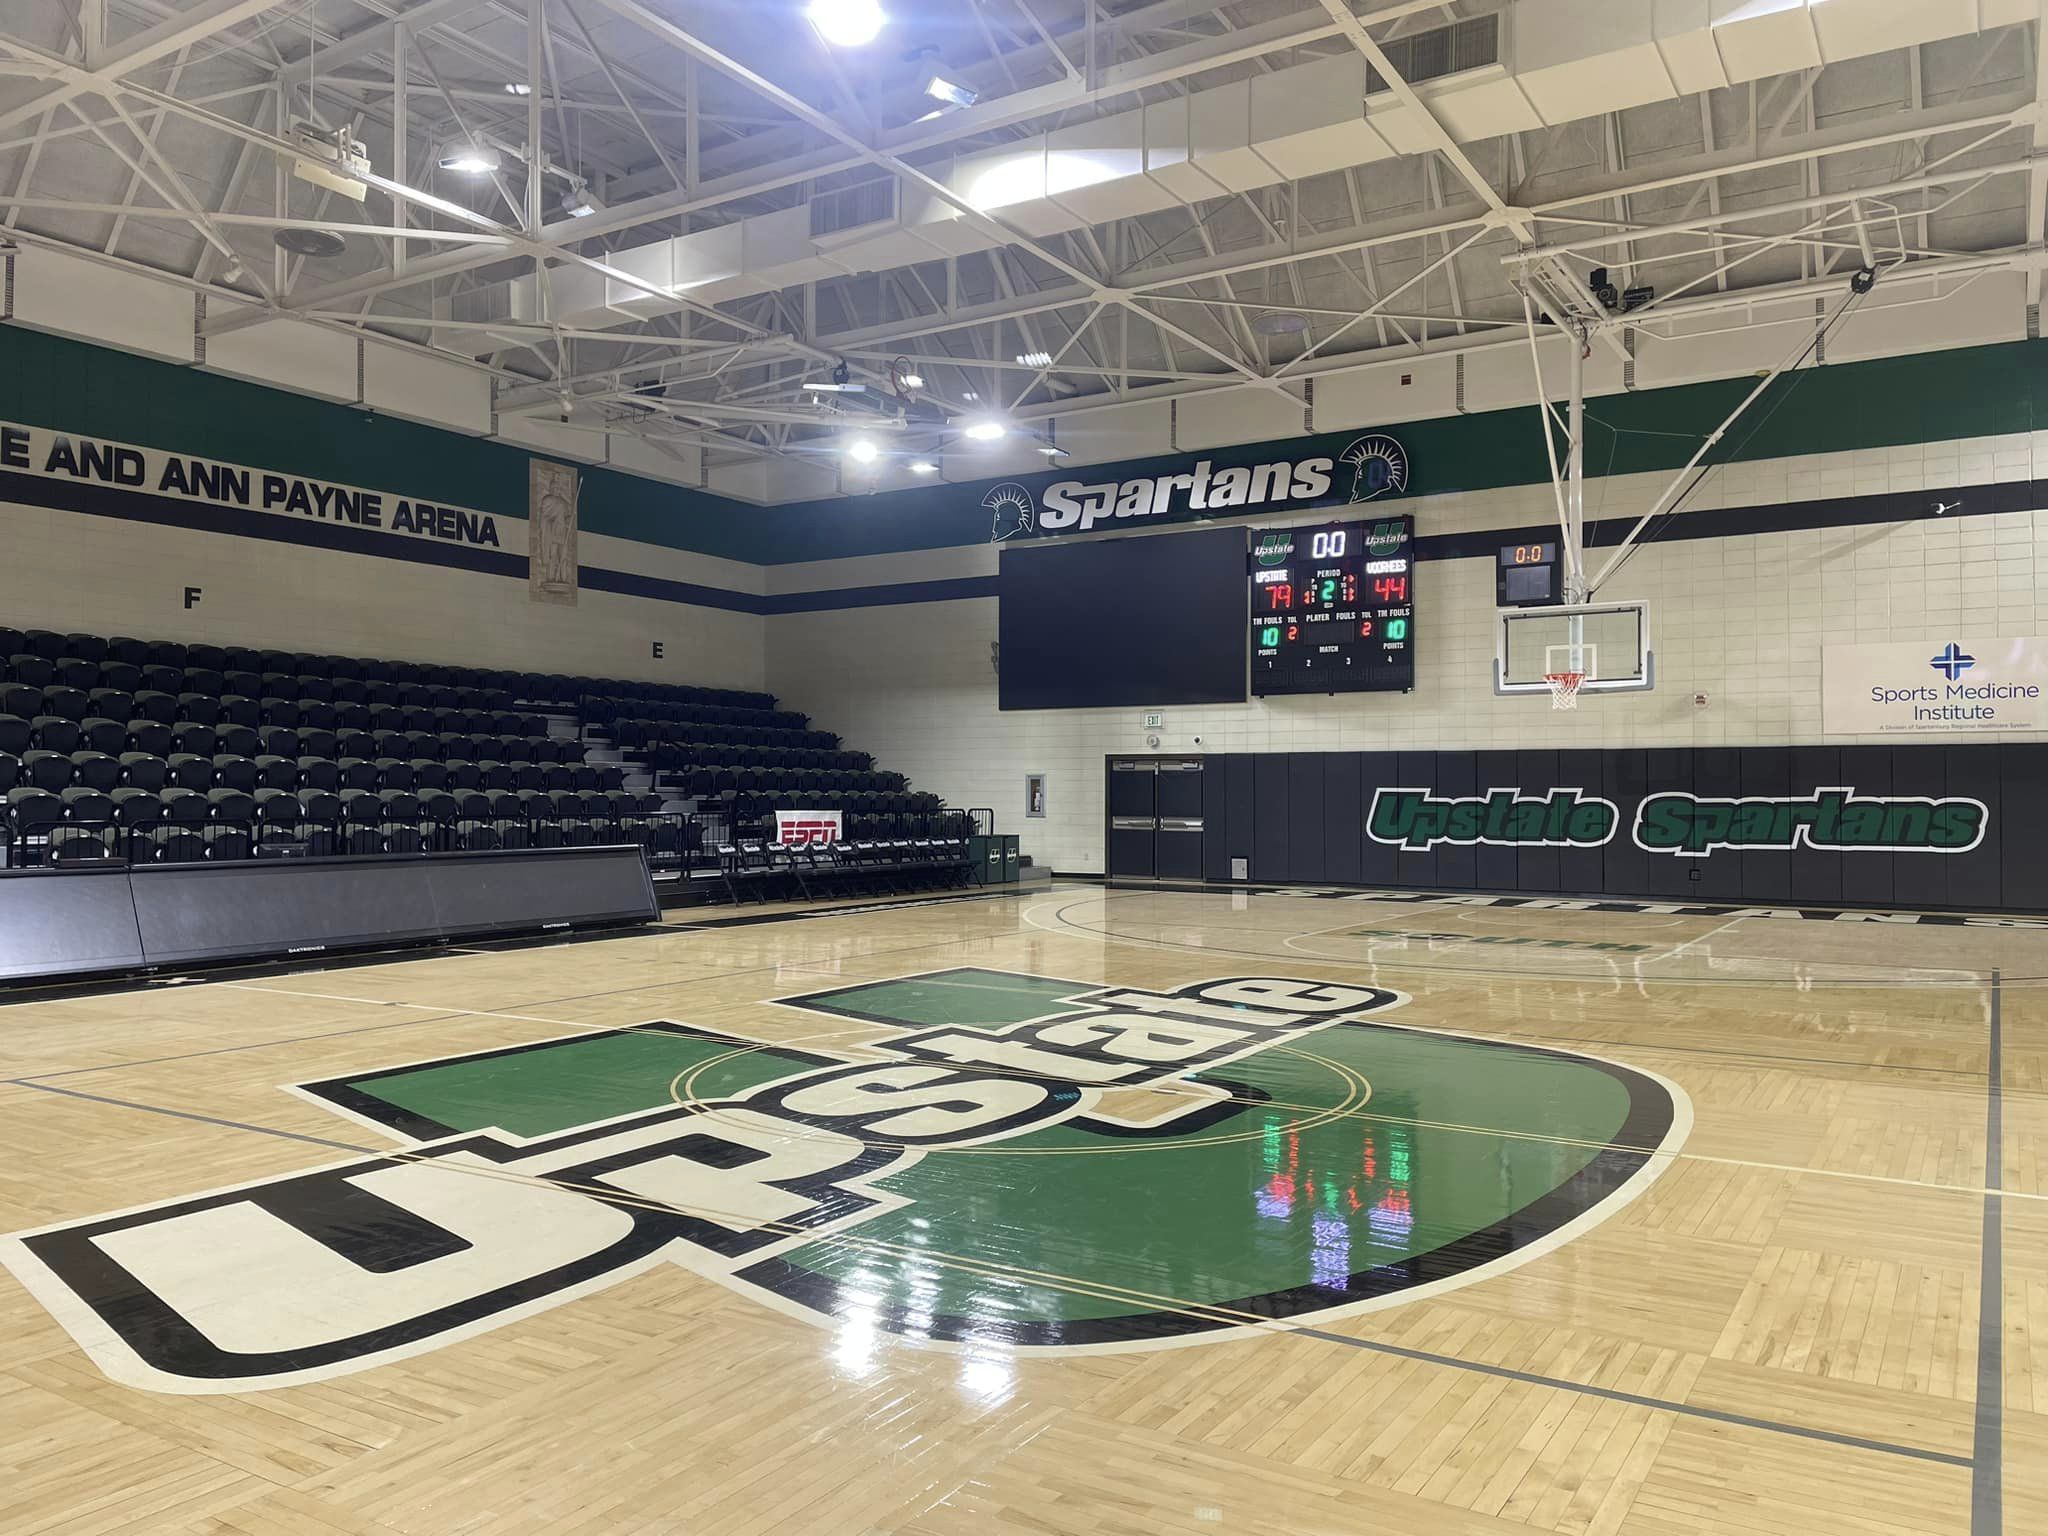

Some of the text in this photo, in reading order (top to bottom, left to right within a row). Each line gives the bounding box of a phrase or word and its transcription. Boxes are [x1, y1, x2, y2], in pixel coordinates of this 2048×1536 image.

[45, 437, 145, 487] AND
[158, 458, 250, 506] ANN
[263, 475, 382, 528] PAYNE
[391, 500, 500, 548] ARENA
[1039, 457, 1333, 530] Spartans
[1365, 531, 1408, 546] Upstate
[1254, 543, 1295, 557] Upstate
[1515, 546, 1542, 563] 0.0
[1317, 569, 1341, 578] PERIOD
[1265, 584, 1292, 609] 79
[1321, 580, 1335, 601] 2
[1375, 577, 1406, 601] 44
[183, 587, 203, 610] F
[1263, 616, 1282, 624] FOULS
[1306, 612, 1356, 622] PLAYER FOULS
[1390, 608, 1410, 617] FOULS
[1262, 627, 1279, 647] 10
[1287, 626, 1298, 640] 2
[1361, 621, 1372, 636] 2
[1387, 619, 1405, 640] 10
[652, 642, 664, 659] E
[1319, 645, 1338, 653] MATCH
[1383, 642, 1404, 650] POINTS
[1871, 682, 2040, 704] Sports Medicine
[1914, 704, 1995, 721] Institute
[1367, 787, 1988, 856] Upstate Spartans
[780, 820, 838, 845] ESPN
[1246, 888, 2048, 929] SPARTANS
[288, 945, 325, 954] DAKTRONICS
[45, 976, 1392, 1370] Upstate
